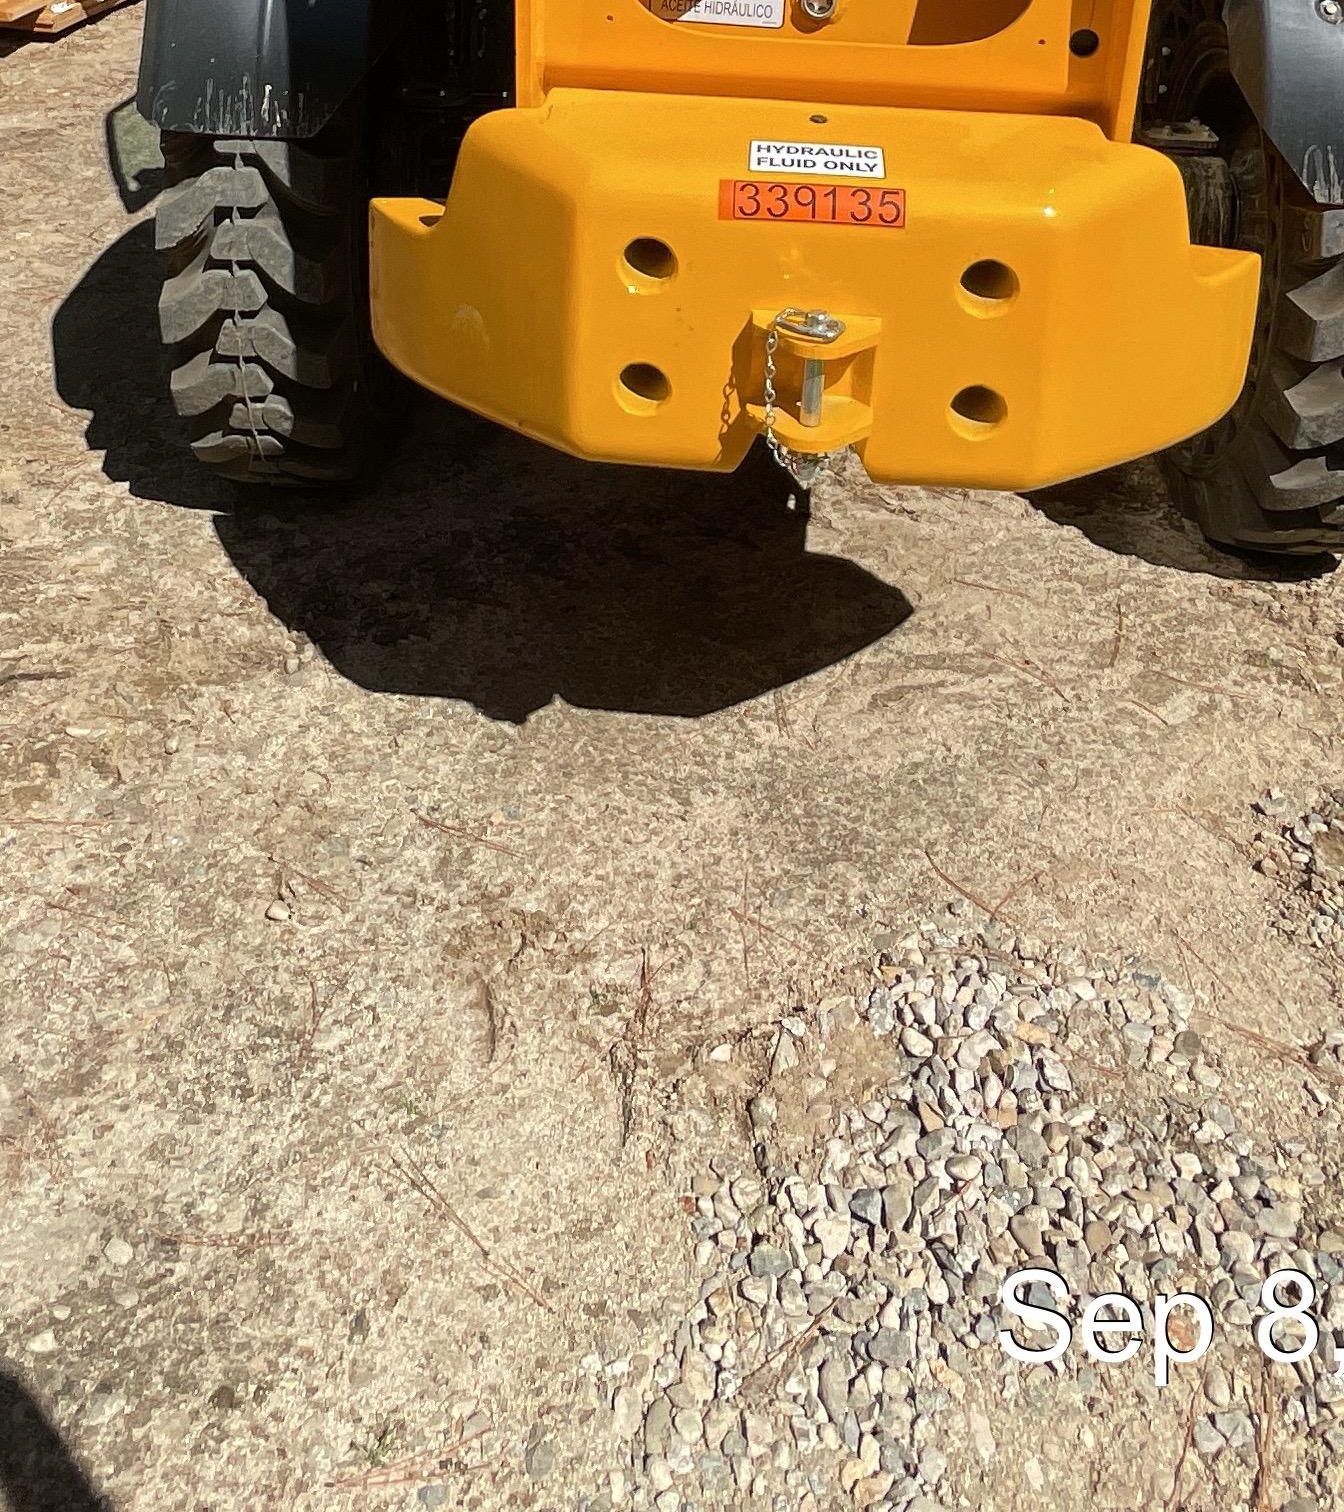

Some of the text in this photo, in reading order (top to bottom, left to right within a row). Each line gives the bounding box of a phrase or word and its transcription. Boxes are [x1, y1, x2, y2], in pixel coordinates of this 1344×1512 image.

[756, 144, 878, 160] HYDRAULIC
[756, 156, 878, 173] FLUID ONLY
[737, 182, 902, 224] 339135
